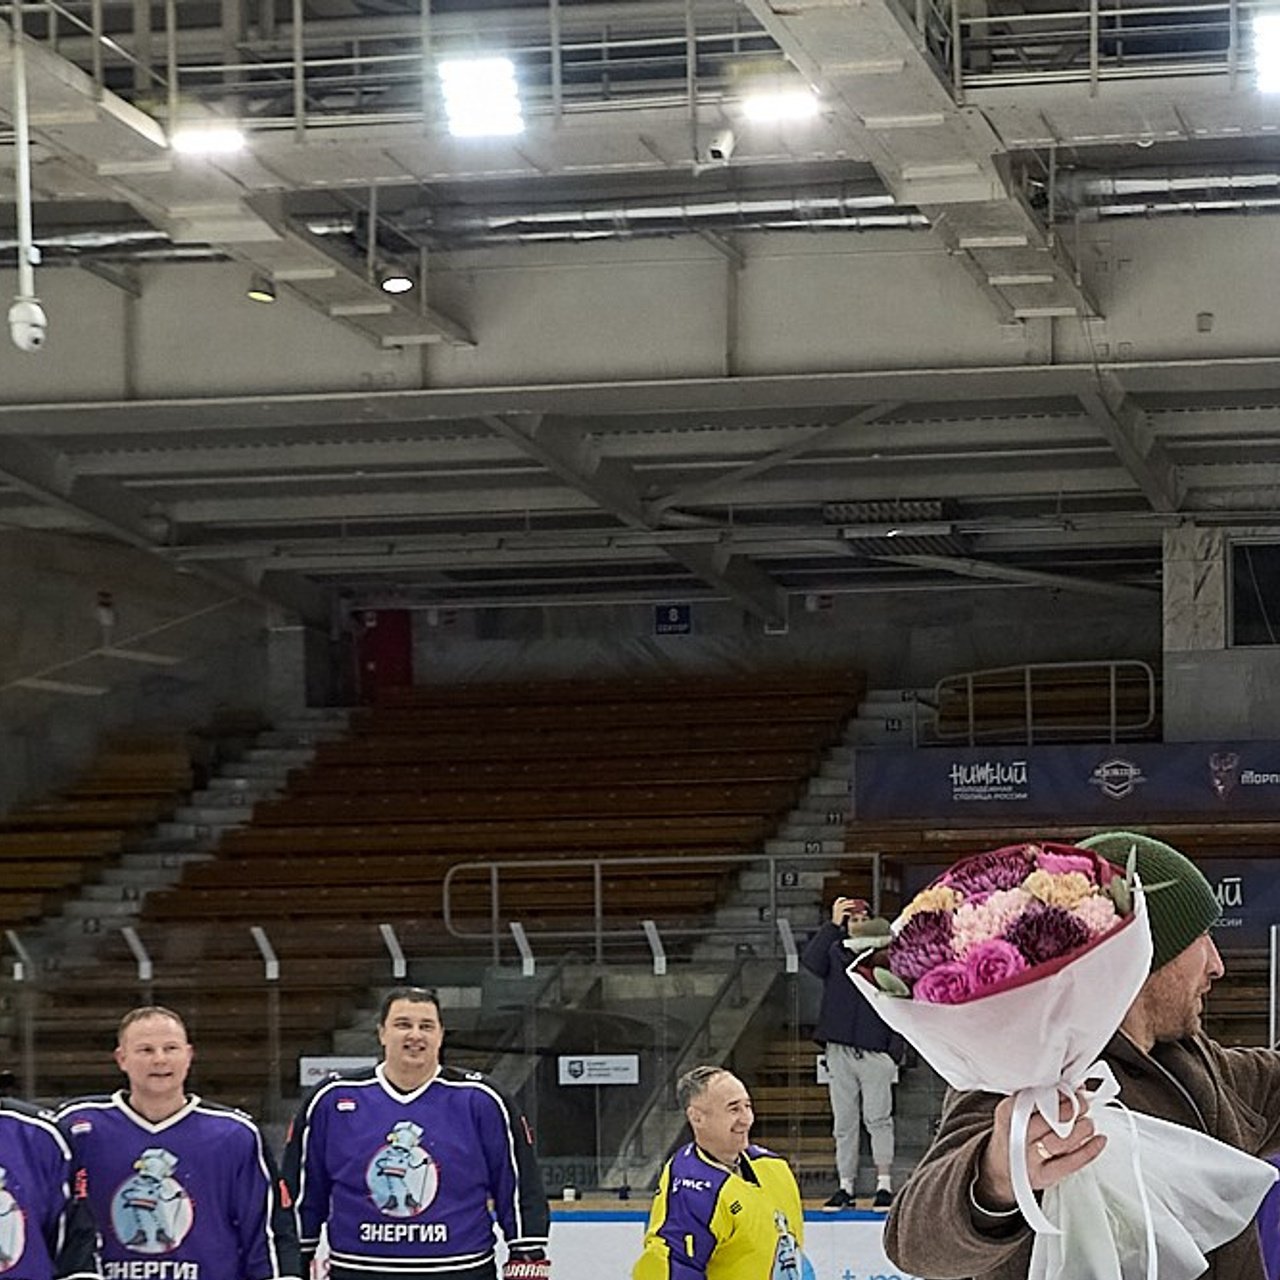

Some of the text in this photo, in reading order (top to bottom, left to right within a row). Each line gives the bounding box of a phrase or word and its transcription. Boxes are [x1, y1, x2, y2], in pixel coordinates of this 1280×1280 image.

[949, 761, 1028, 786] НИЖНИЙ
[360, 1223, 448, 1242] ЭНЕРГИЯ
[684, 1234, 694, 1258] 1
